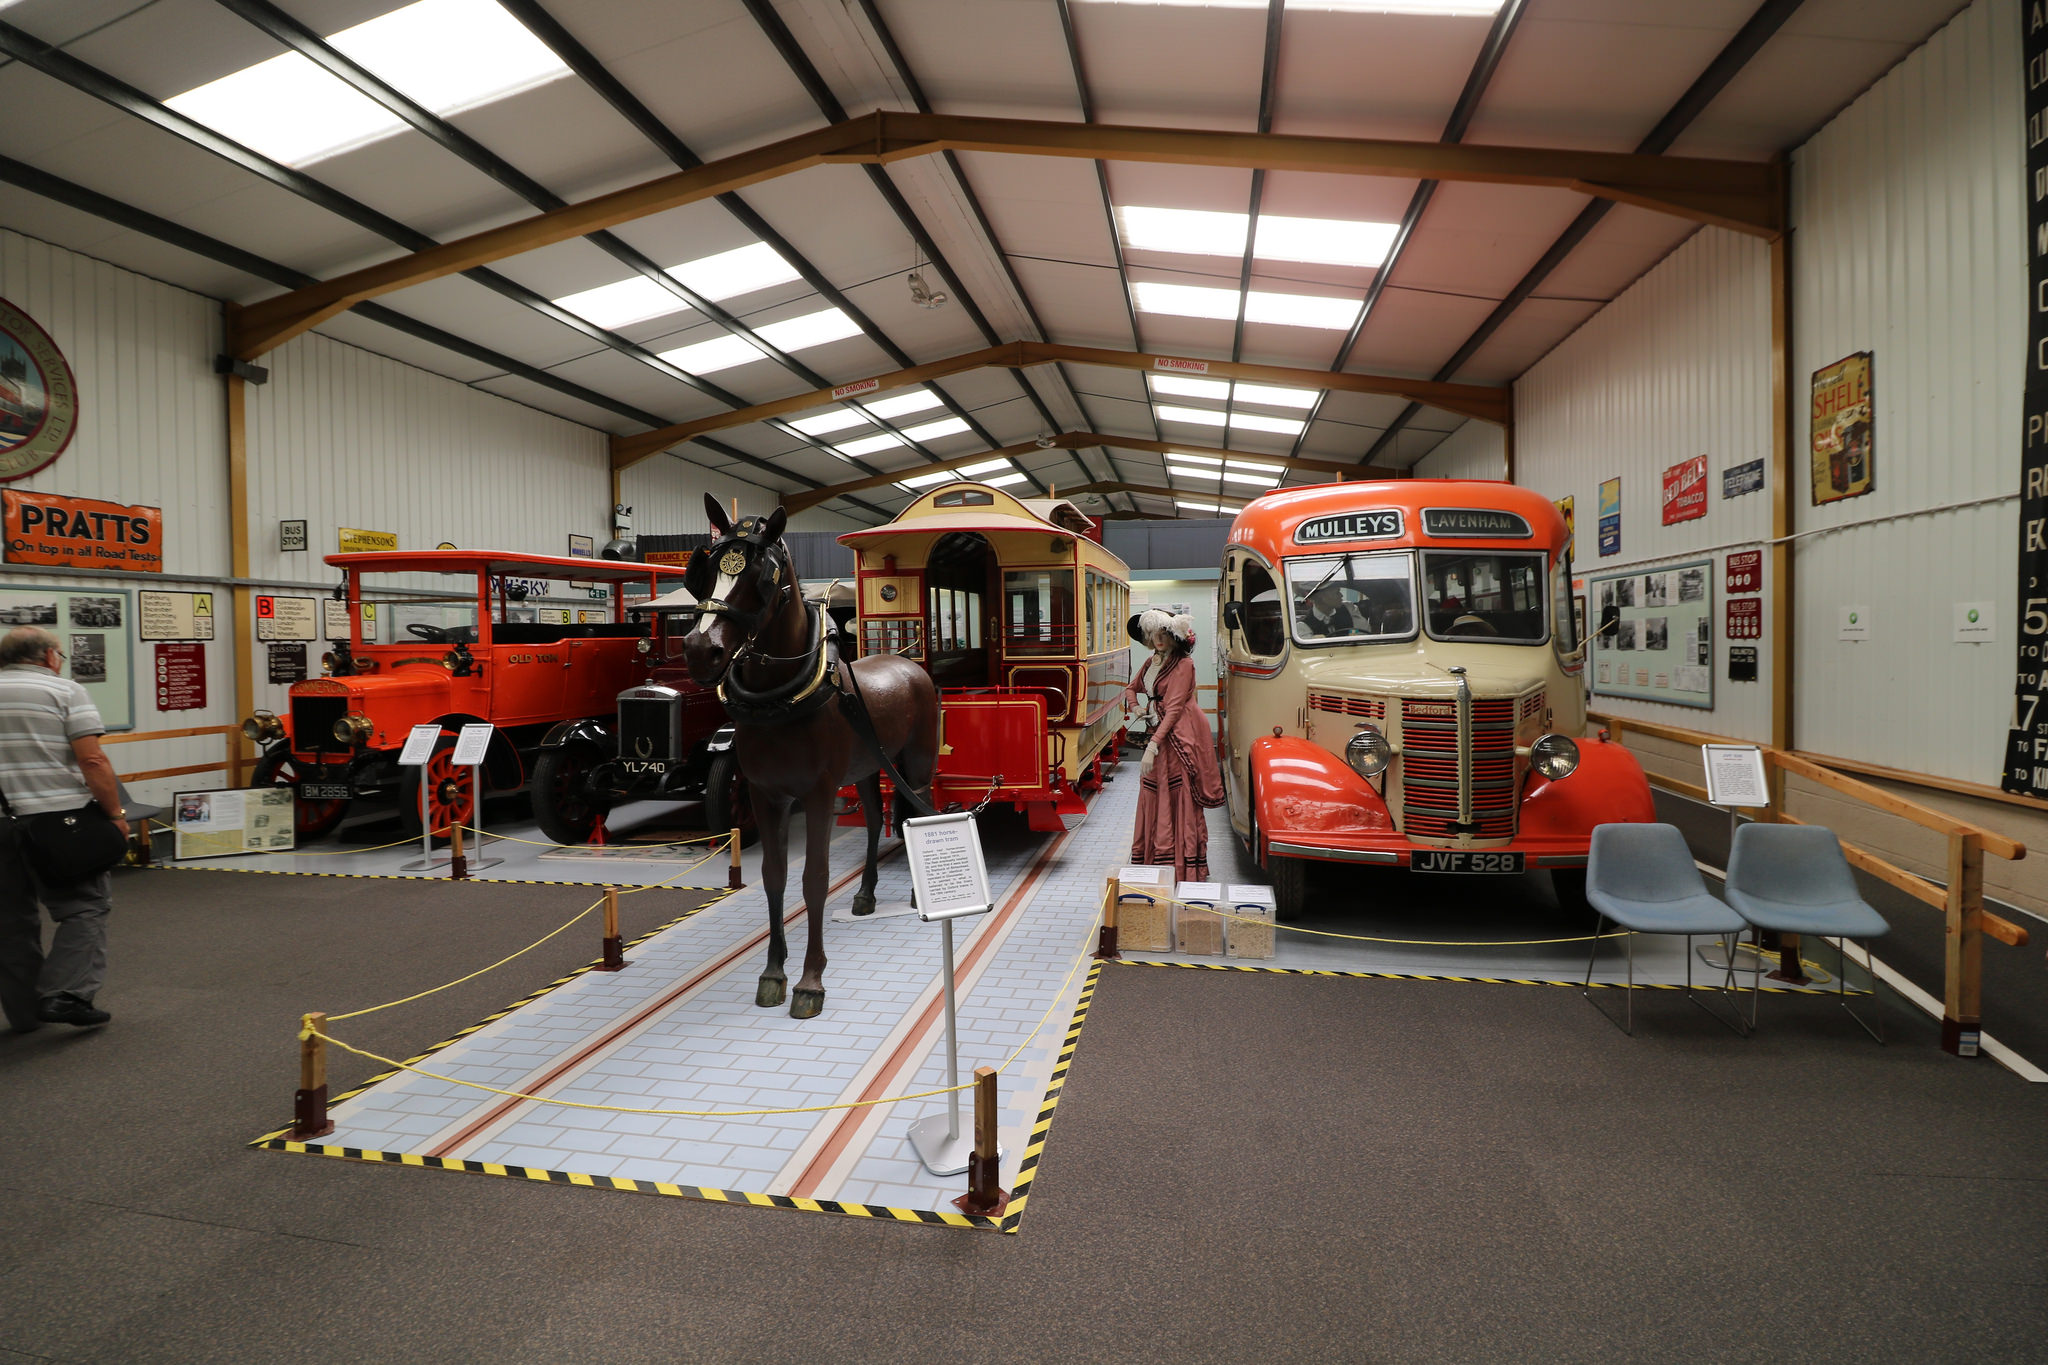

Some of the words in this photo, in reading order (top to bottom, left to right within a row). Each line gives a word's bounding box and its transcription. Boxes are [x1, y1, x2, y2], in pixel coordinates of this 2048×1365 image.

[1158, 358, 1168, 368] NO
[1170, 360, 1205, 371] SMOKING
[32, 341, 69, 409] SERVICES
[834, 388, 844, 398] NO
[845, 381, 876, 396] SMOKING
[1813, 379, 1865, 419] SHELL
[1664, 480, 1680, 506] RED
[1681, 460, 1704, 492] BELL
[1677, 492, 1704, 508] TOBACCO
[20, 504, 150, 544] PRATTS
[1306, 516, 1396, 538] MULLEYS
[1430, 514, 1512, 528] LAVENHAM
[284, 526, 302, 534] BUS
[282, 537, 304, 545] STOP
[343, 532, 394, 547] STEPHENSONS
[13, 539, 34, 552] On
[38, 542, 60, 556] top
[63, 545, 74, 556] in
[96, 546, 126, 560] Road
[128, 549, 158, 562] Tests
[1730, 556, 1740, 566] BUS
[1741, 554, 1758, 564] STOP
[196, 598, 210, 613] A
[260, 600, 271, 615] B
[364, 603, 373, 618] C
[1730, 602, 1740, 611] BUS
[1742, 601, 1756, 610] STOP
[562, 612, 568, 623] B
[580, 613, 585, 623] C
[509, 654, 532, 663] OLD
[536, 654, 559, 663] TOM
[2018, 674, 2036, 686] TO
[1410, 705, 1450, 714] Bedford
[2017, 741, 2028, 752] TO
[2015, 768, 2028, 780] TO
[305, 786, 319, 797] BM
[322, 785, 348, 797] 2856
[1420, 853, 1465, 871] JVF
[1471, 854, 1514, 872] 528
